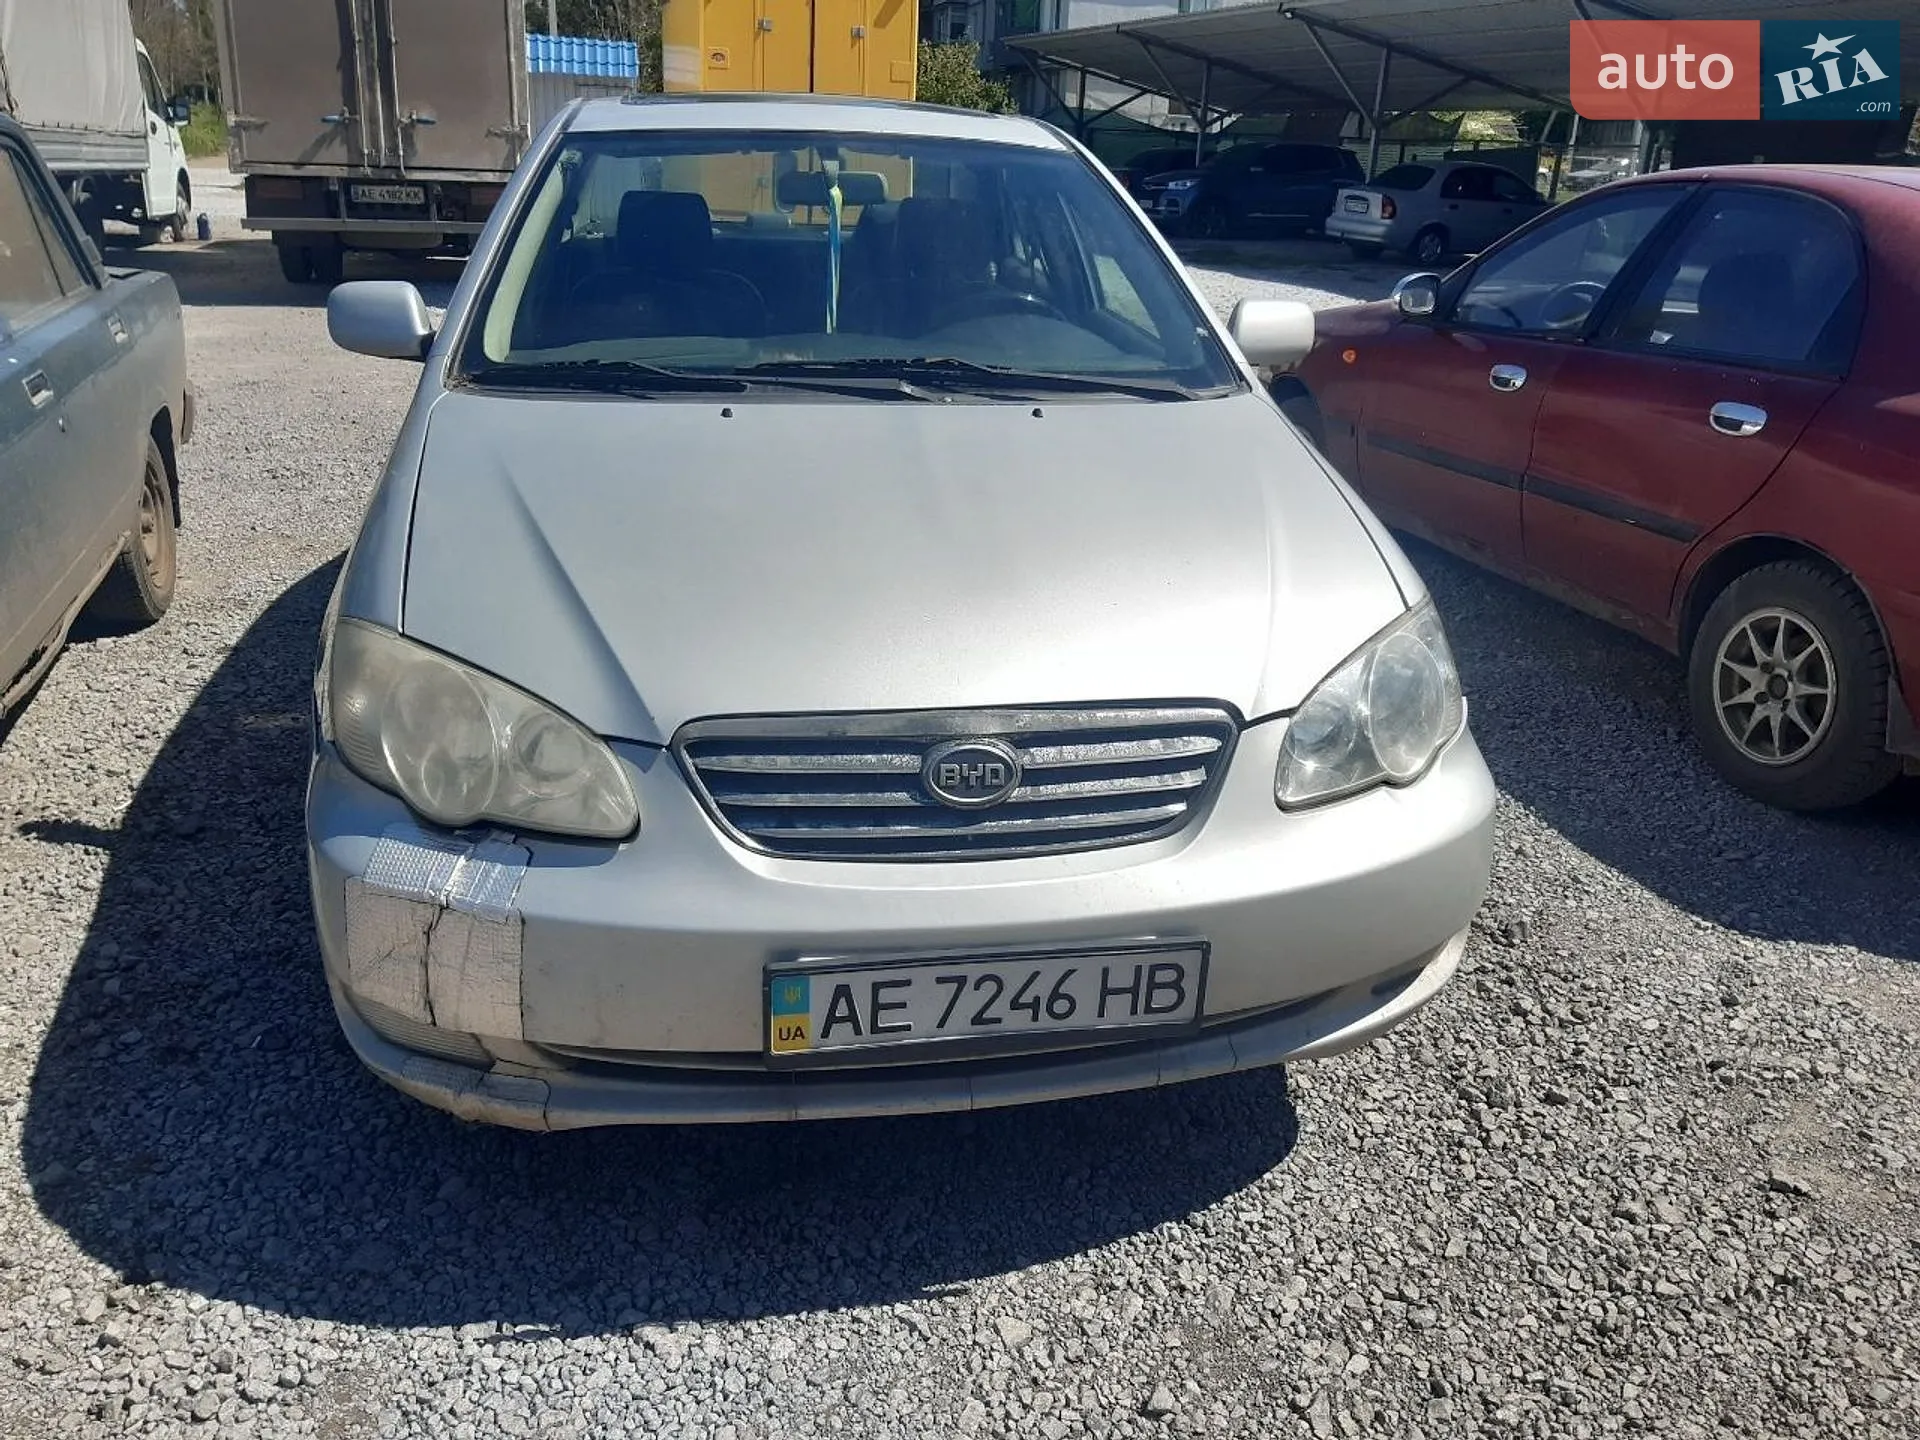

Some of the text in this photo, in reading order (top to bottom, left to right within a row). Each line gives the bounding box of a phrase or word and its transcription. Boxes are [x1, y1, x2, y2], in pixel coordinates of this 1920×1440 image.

[360, 188, 376, 200] AE
[940, 763, 1005, 786] BYD
[820, 962, 1186, 1039] AE 7246 HB
[778, 1025, 806, 1041] UA
